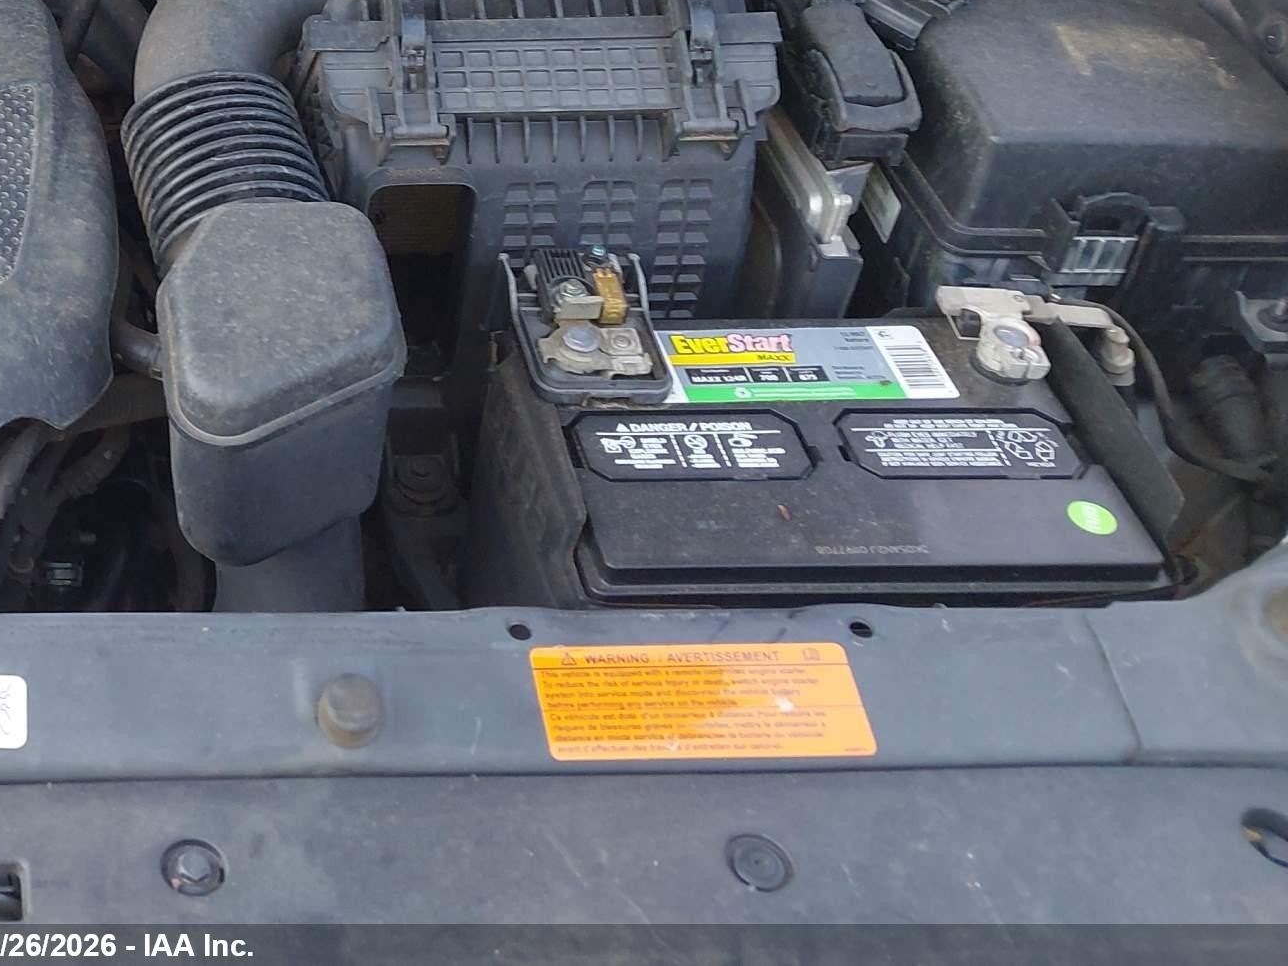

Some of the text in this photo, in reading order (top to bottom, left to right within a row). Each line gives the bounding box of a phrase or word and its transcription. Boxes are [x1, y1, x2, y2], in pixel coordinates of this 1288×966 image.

[670, 333, 793, 354] EverStart
[629, 423, 688, 432] DANGER
[699, 422, 753, 431] POISON
[584, 652, 650, 664] WARNING
[667, 650, 779, 663] AVERTISSEMENT
